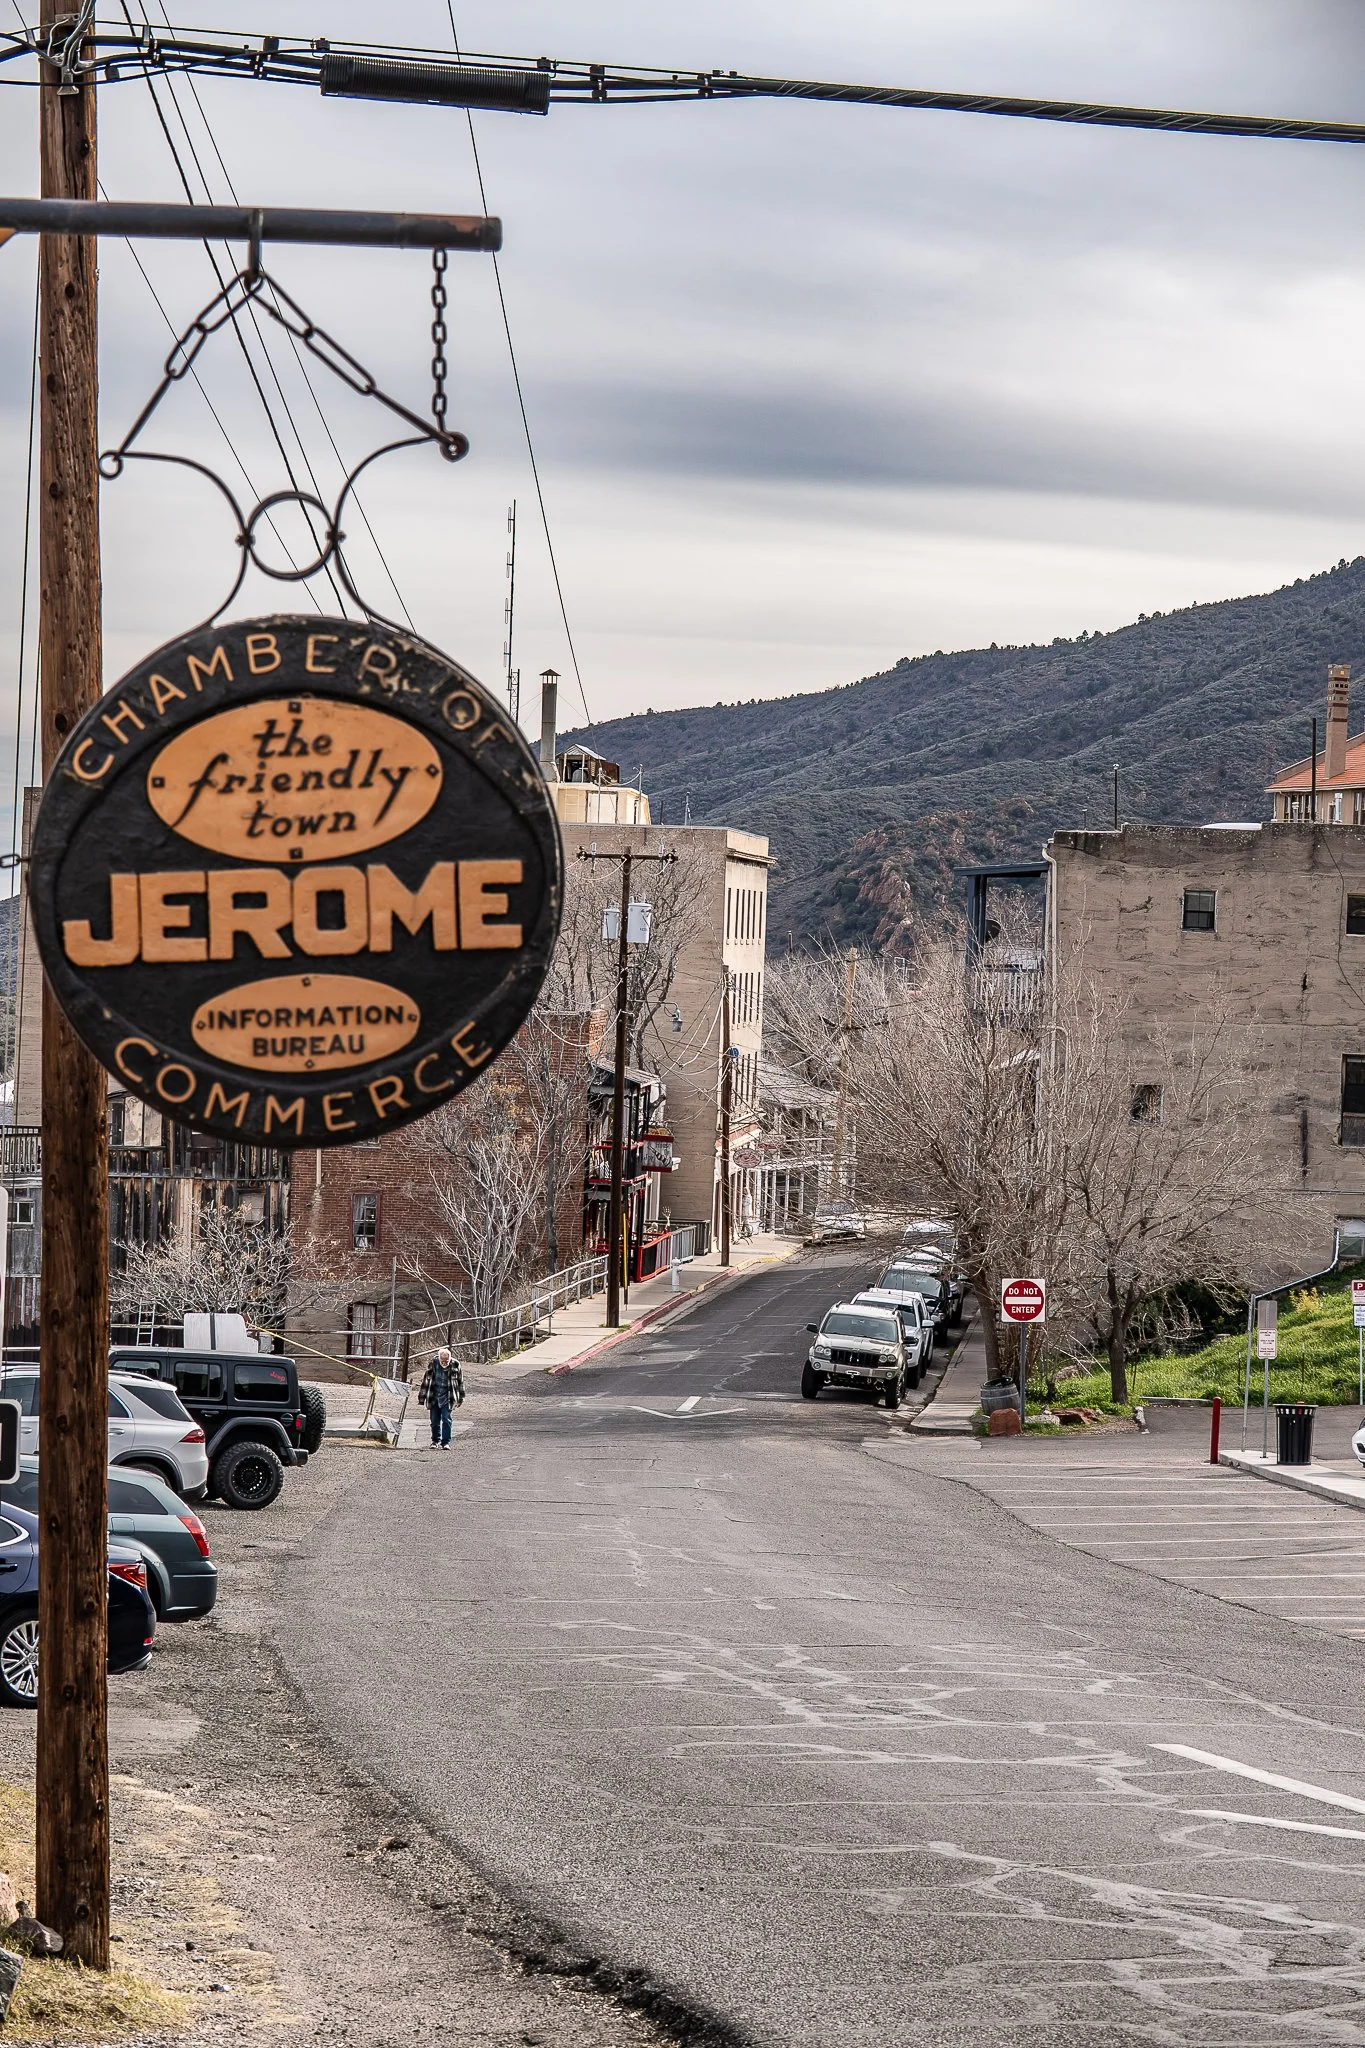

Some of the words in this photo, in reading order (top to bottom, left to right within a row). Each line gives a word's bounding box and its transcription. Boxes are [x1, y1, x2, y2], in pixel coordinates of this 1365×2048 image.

[72, 633, 398, 780] CHAMBER
[442, 690, 514, 749] OF
[252, 718, 333, 758] the
[170, 748, 412, 829] friendly
[242, 801, 356, 838] town
[62, 859, 524, 967] JEROME
[208, 1005, 404, 1030] INFORMATION
[252, 1034, 365, 1057] BUREAU
[114, 1021, 492, 1136] COMMERCE
[1008, 1287, 1020, 1295] DO
[1023, 1287, 1039, 1295] NOT
[1011, 1306, 1036, 1314] ENTER
